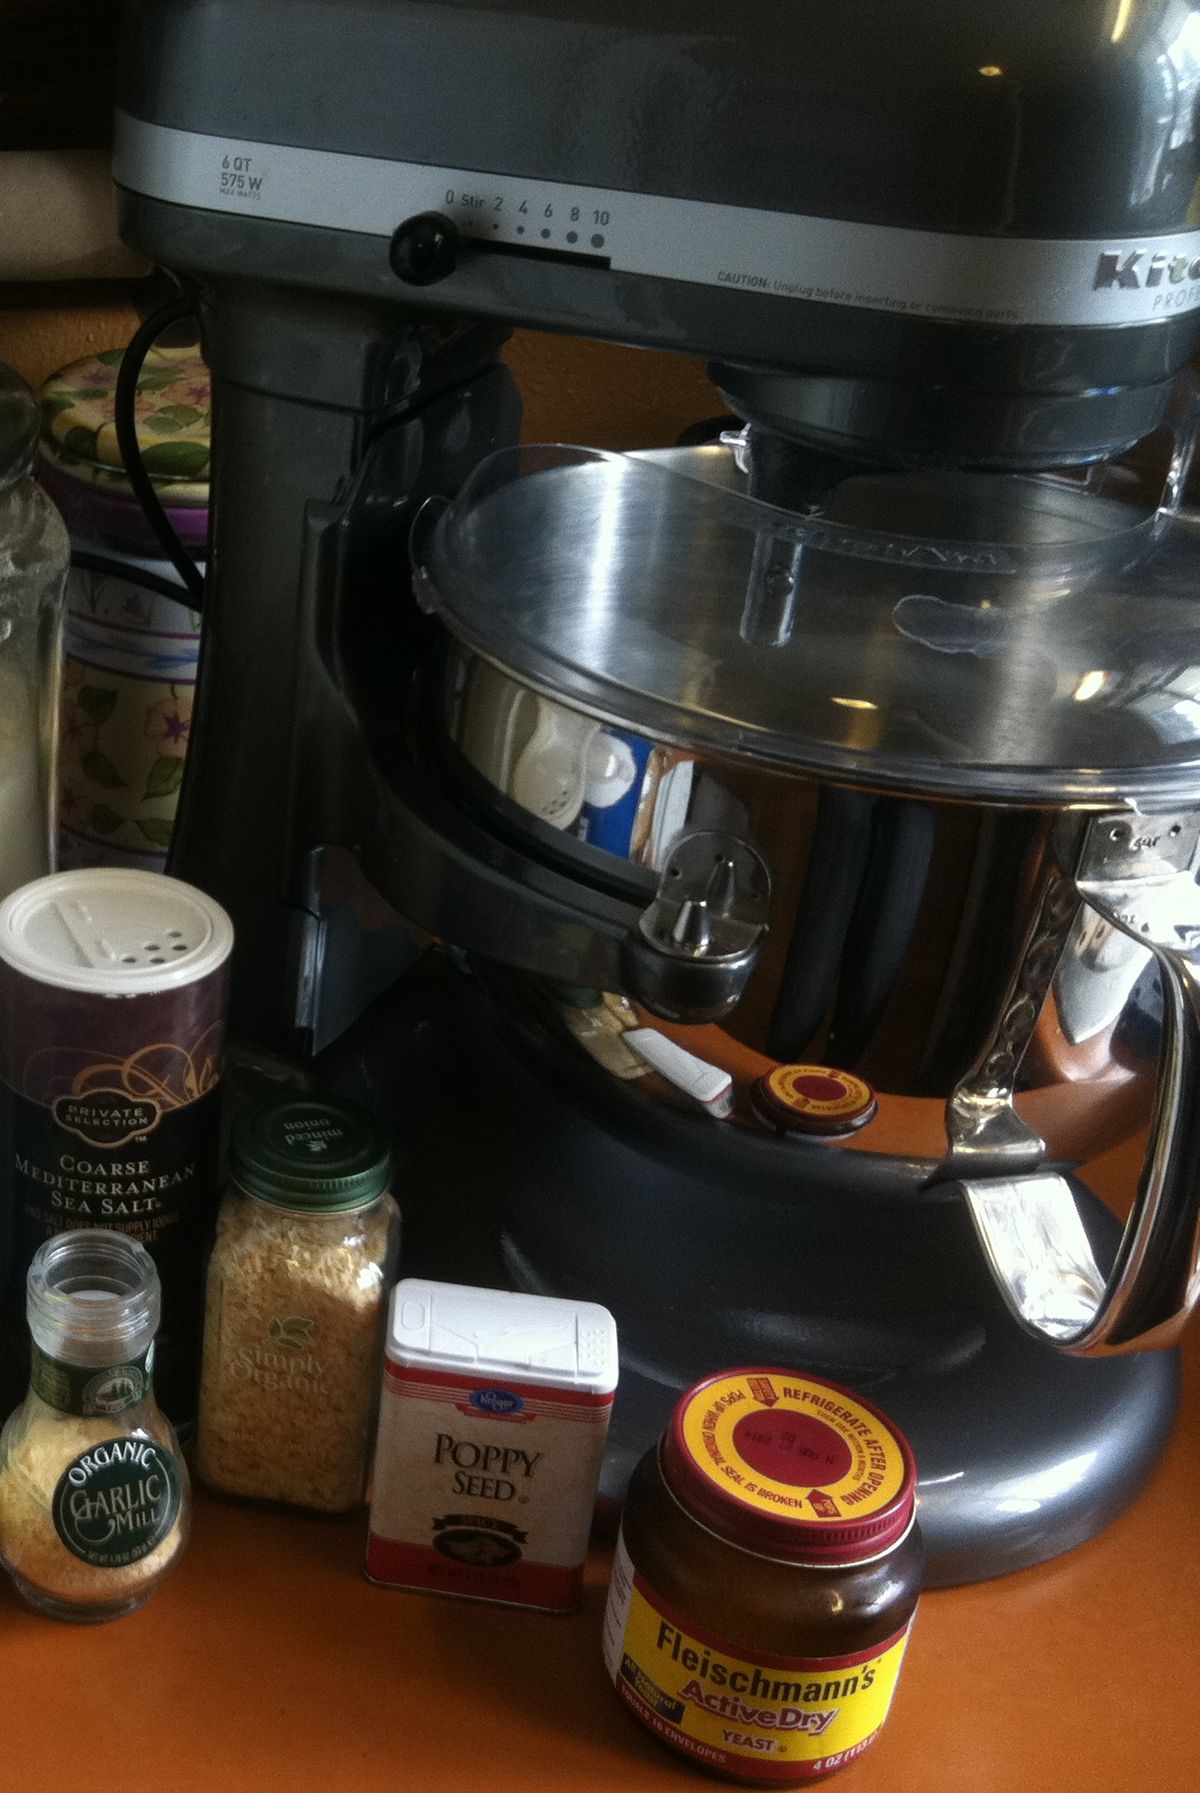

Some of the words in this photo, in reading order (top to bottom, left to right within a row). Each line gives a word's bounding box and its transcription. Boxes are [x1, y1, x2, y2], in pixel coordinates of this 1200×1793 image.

[221, 154, 230, 169] 6
[233, 156, 253, 173] QT
[220, 172, 245, 189] 575
[248, 176, 263, 191] W
[445, 189, 455, 204] 0
[461, 193, 486, 208] Stir
[493, 196, 504, 212] 2
[518, 199, 529, 215] 4
[543, 203, 554, 219] 6
[569, 206, 580, 222] 8
[593, 209, 610, 226] 10
[772, 279, 813, 298] Unplug
[814, 286, 854, 302] before
[65, 1114, 148, 1127] SELECTION
[68, 1105, 144, 1118] PRIVATE
[283, 1118, 331, 1131] onion
[283, 1127, 344, 1146] minced
[14, 1153, 196, 1195] MEDITERRANEAN
[59, 1154, 150, 1177] COARSE
[51, 1190, 92, 1214] SEA
[101, 1198, 156, 1215] SALT
[115, 1217, 151, 1234] SUPPLY
[712, 1400, 726, 1413] UP
[720, 1389, 746, 1406] POPS
[702, 1410, 721, 1431] WHEN
[782, 1386, 873, 1438] REFRIGERATE
[68, 1441, 157, 1488] ORGANIC
[434, 1432, 545, 1479] POPPY
[863, 1438, 887, 1472] AFTER
[452, 1470, 516, 1502] SEED
[720, 1465, 744, 1488] SEAL
[744, 1481, 758, 1494] IS
[69, 1474, 162, 1522] GARLIC
[757, 1487, 803, 1510] BROKEN
[840, 1472, 886, 1506] OPENING
[114, 1509, 160, 1535] MILL
[657, 1619, 877, 1704] Fleischmann's
[621, 1683, 650, 1721] EQUALS
[663, 1727, 728, 1764] ENVELOPES
[721, 1728, 777, 1752] YEAST
[812, 1760, 822, 1771] 4
[824, 1753, 843, 1768] OZ
